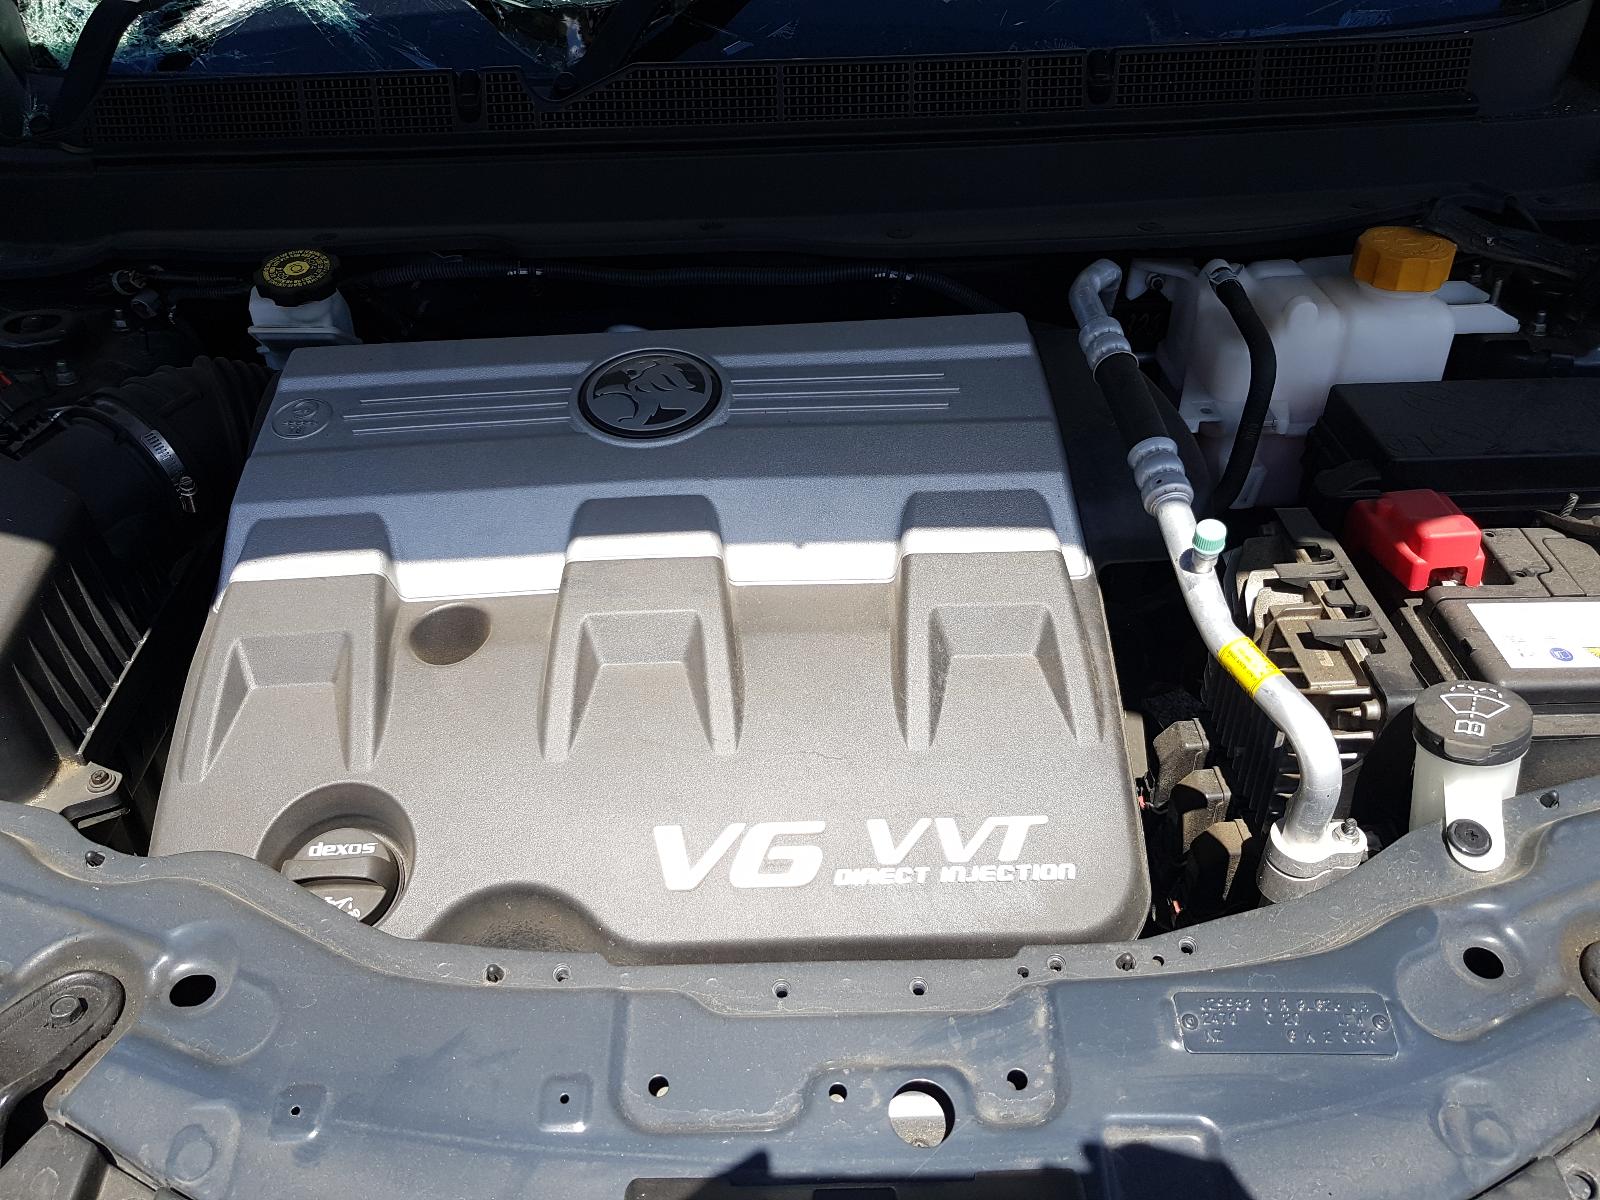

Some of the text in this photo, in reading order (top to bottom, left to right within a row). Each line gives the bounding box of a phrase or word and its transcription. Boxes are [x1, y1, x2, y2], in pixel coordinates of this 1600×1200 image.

[307, 841, 379, 857] dexos
[652, 820, 826, 892] V6
[865, 815, 1049, 866] VVT
[833, 863, 1077, 887] DIRECT INJECTION
